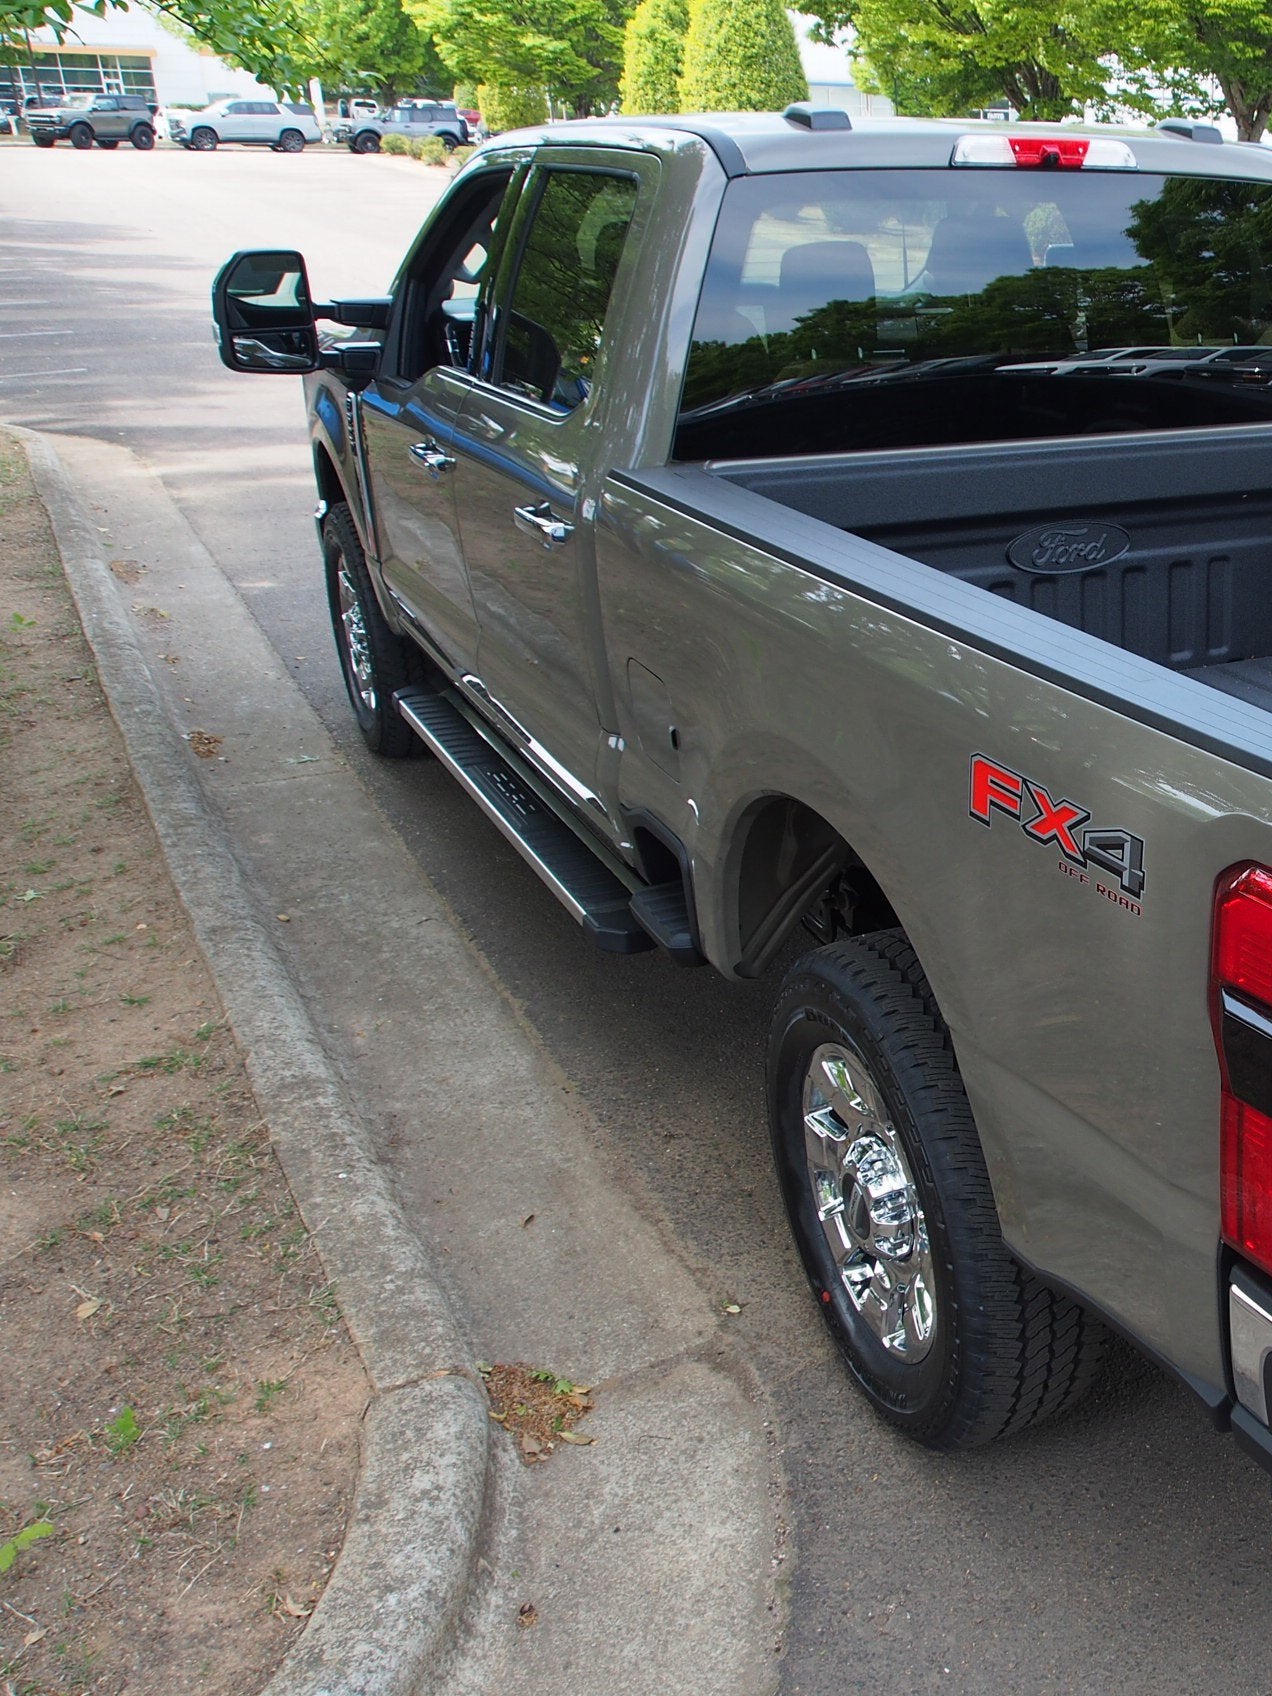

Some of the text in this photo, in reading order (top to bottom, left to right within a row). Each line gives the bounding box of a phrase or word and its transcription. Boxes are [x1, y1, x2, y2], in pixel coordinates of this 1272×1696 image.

[1032, 527, 1107, 567] Ford
[968, 751, 1145, 901] FX4
[1058, 860, 1143, 917] OFF ROAD
